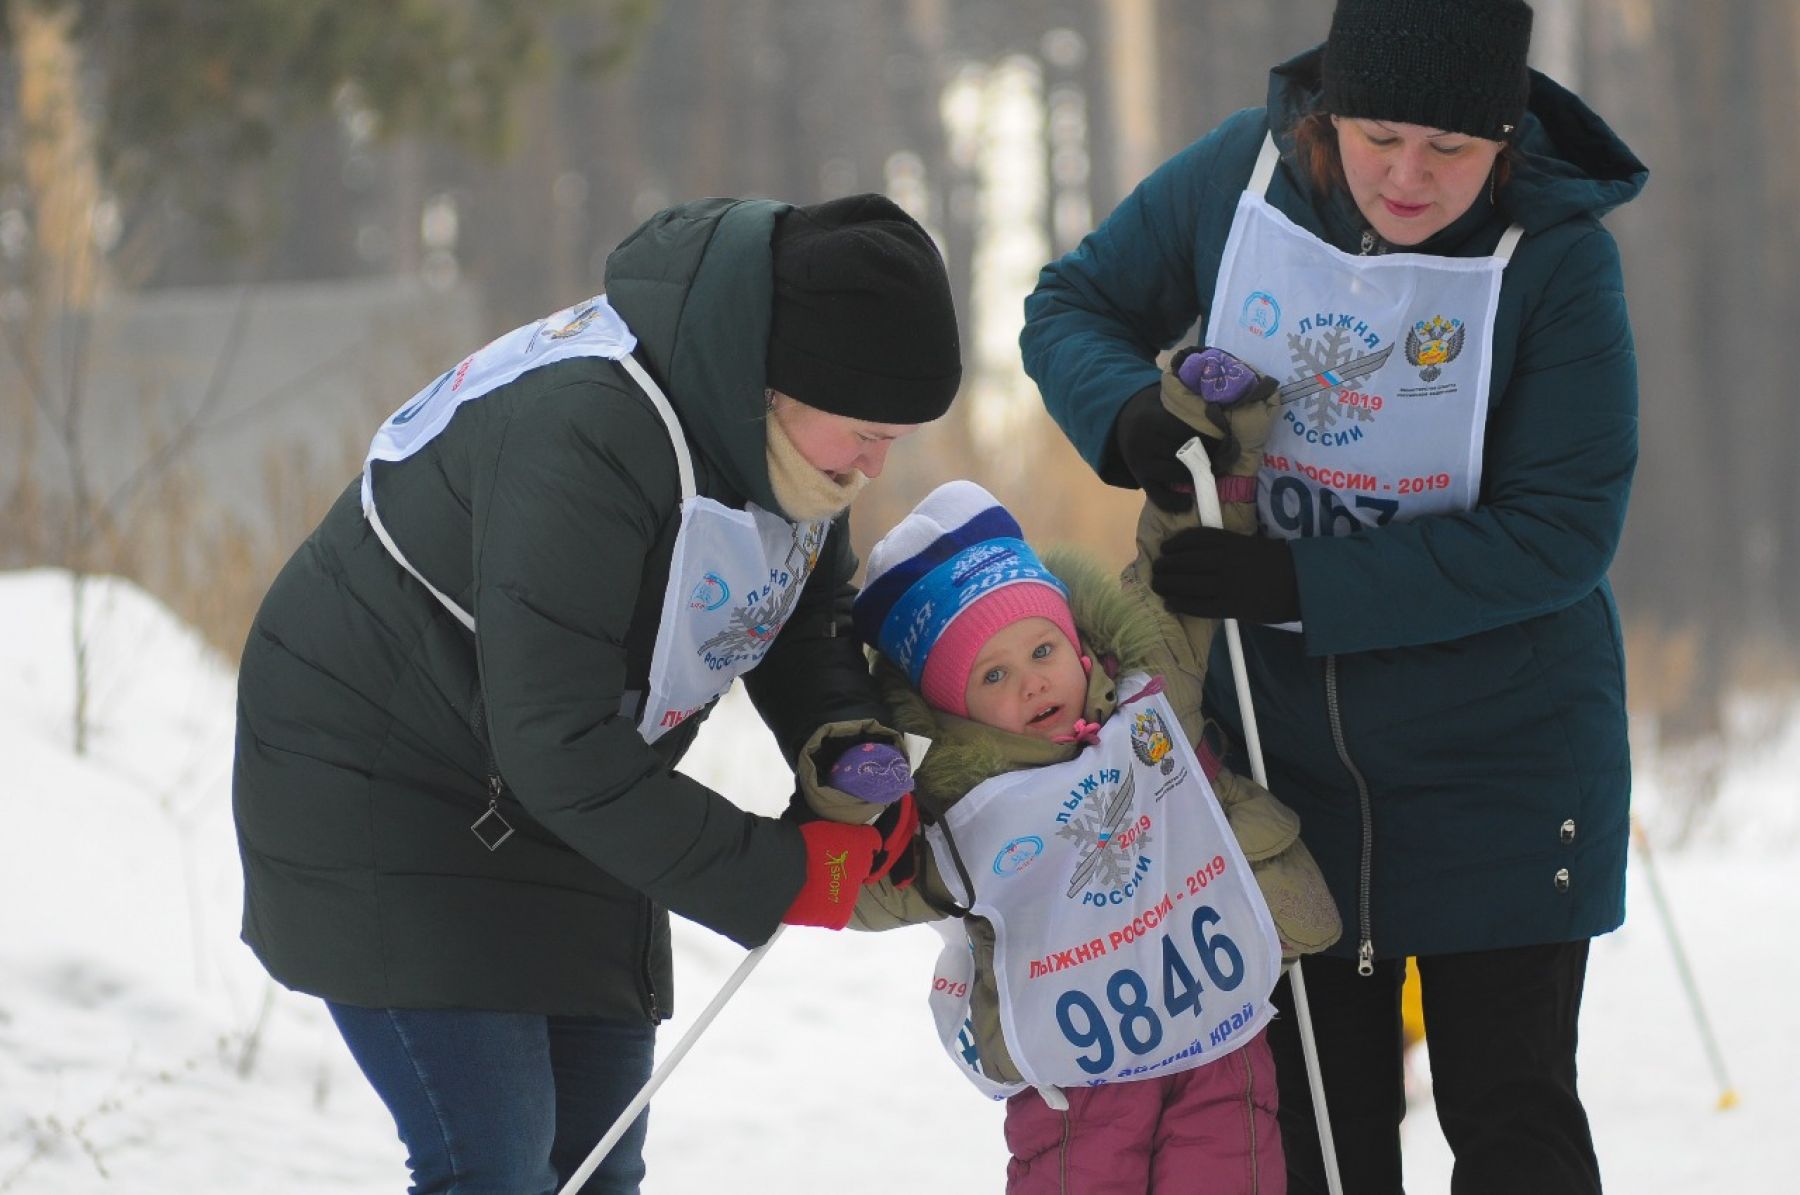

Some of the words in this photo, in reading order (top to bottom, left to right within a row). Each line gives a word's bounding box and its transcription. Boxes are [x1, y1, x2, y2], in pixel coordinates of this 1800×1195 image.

[1299, 313, 1380, 349] ЛЫЖНЯ
[1338, 389, 1383, 410] 2019
[1283, 411, 1364, 447] РОССИИ
[1263, 454, 1290, 472] НЯ
[1398, 473, 1451, 494] 2019
[1056, 769, 1120, 823] ЛЫЖНЯ
[1117, 815, 1151, 849] 2019
[1083, 856, 1152, 907] РОССИИ
[1028, 937, 1106, 979] ЛЫЖНЯ
[1109, 892, 1173, 950] РОССИИ
[1187, 855, 1226, 897] 2019
[933, 977, 967, 998] 019
[1055, 904, 1245, 1075] 9846
[1211, 1003, 1254, 1048] край
